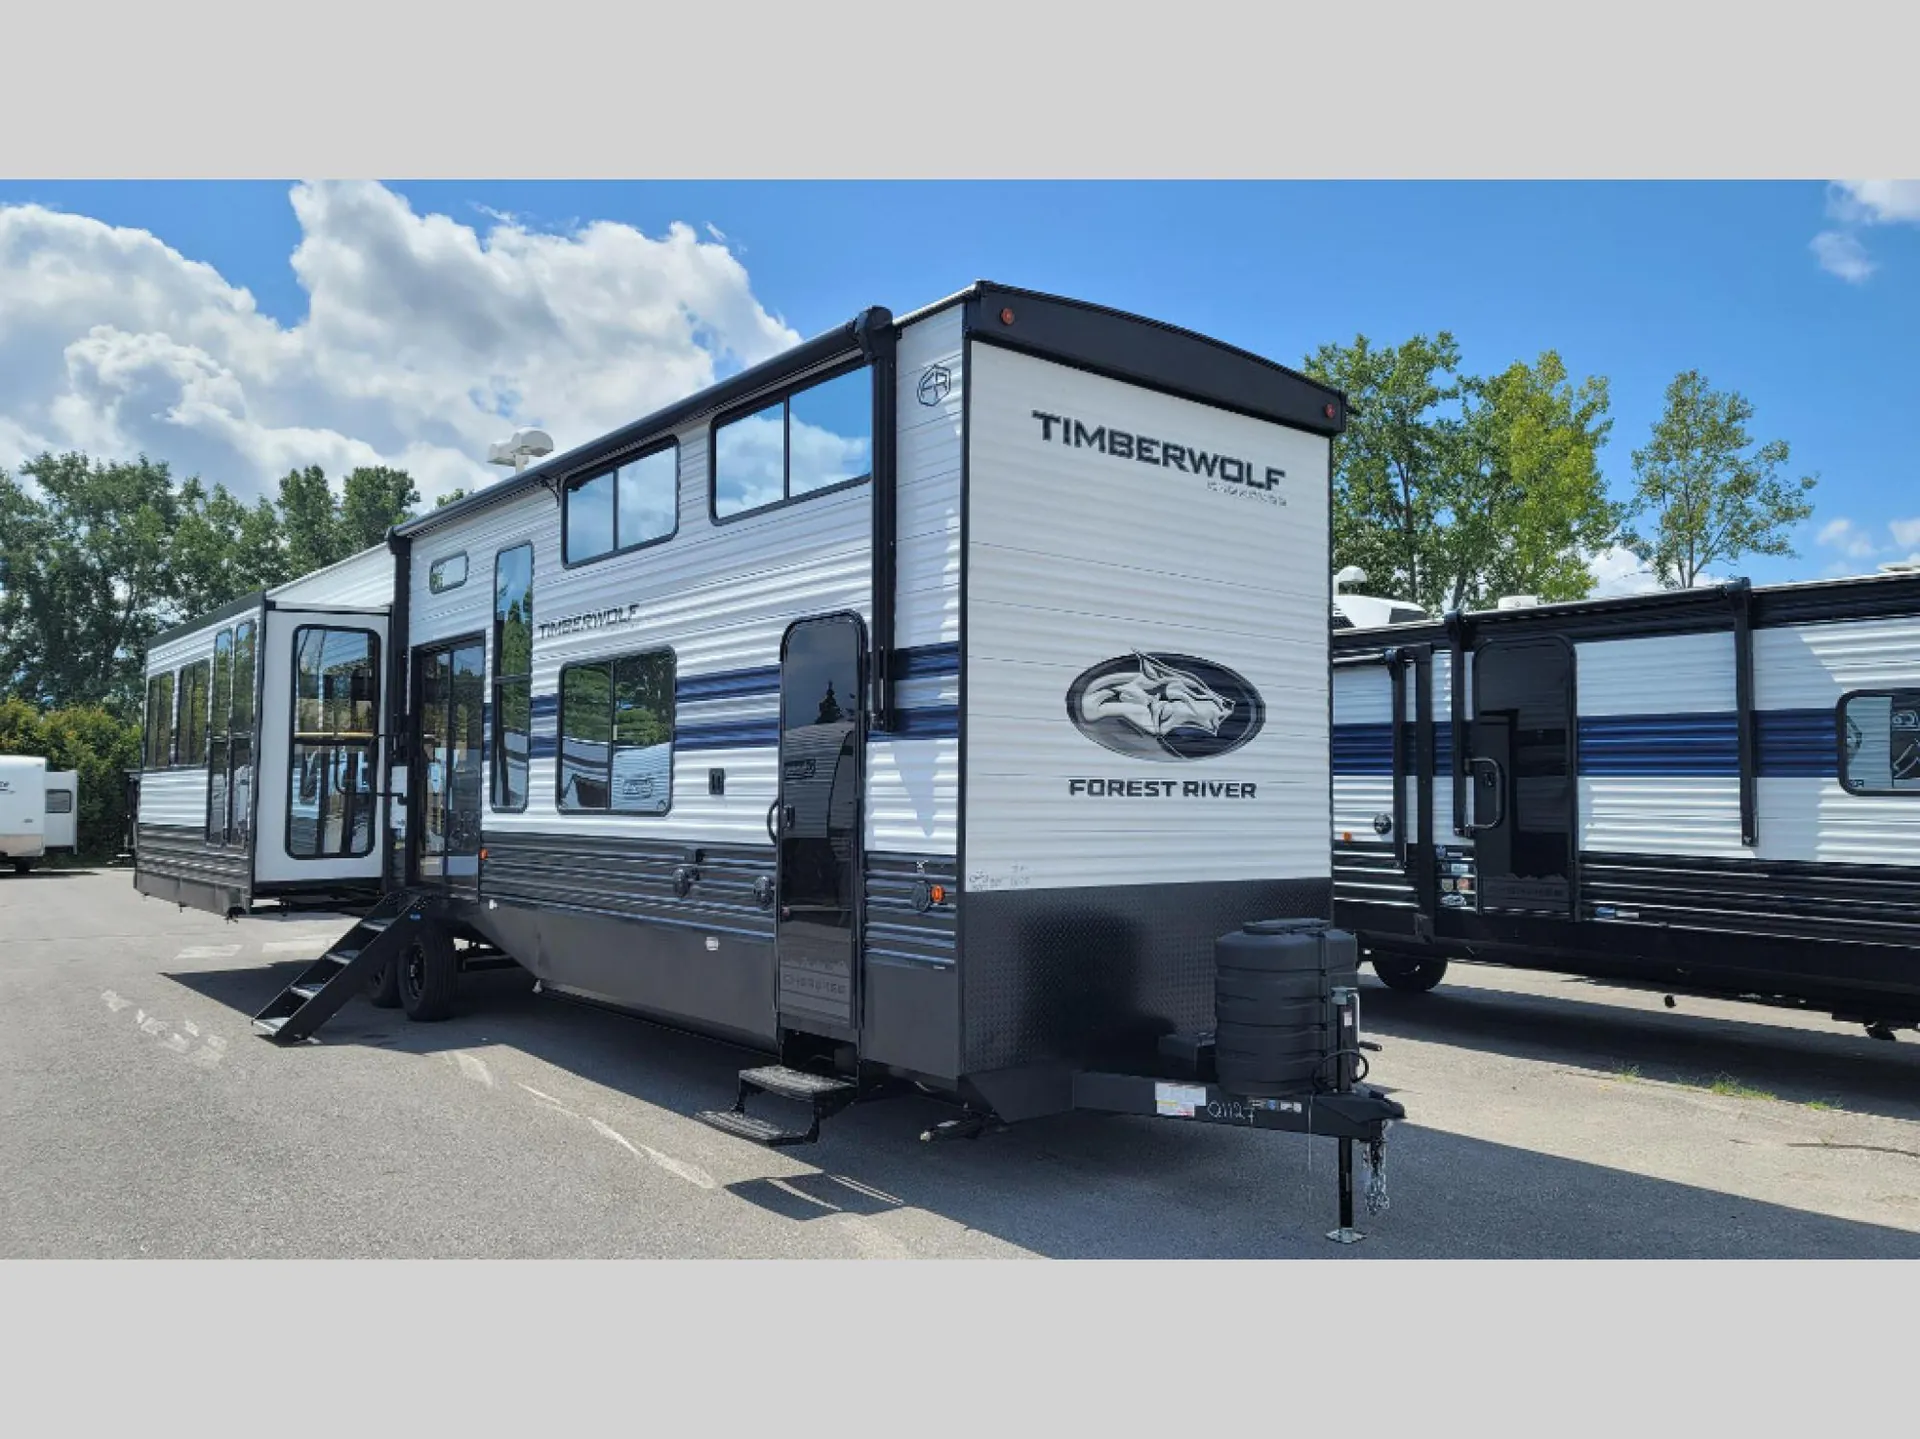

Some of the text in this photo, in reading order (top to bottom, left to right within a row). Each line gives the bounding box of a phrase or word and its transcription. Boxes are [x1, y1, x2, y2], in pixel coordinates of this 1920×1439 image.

[1031, 408, 1286, 491] TIMBERWOLF
[538, 603, 640, 639] TIMBERWOLF
[1068, 778, 1257, 799] FOREST RIVER
